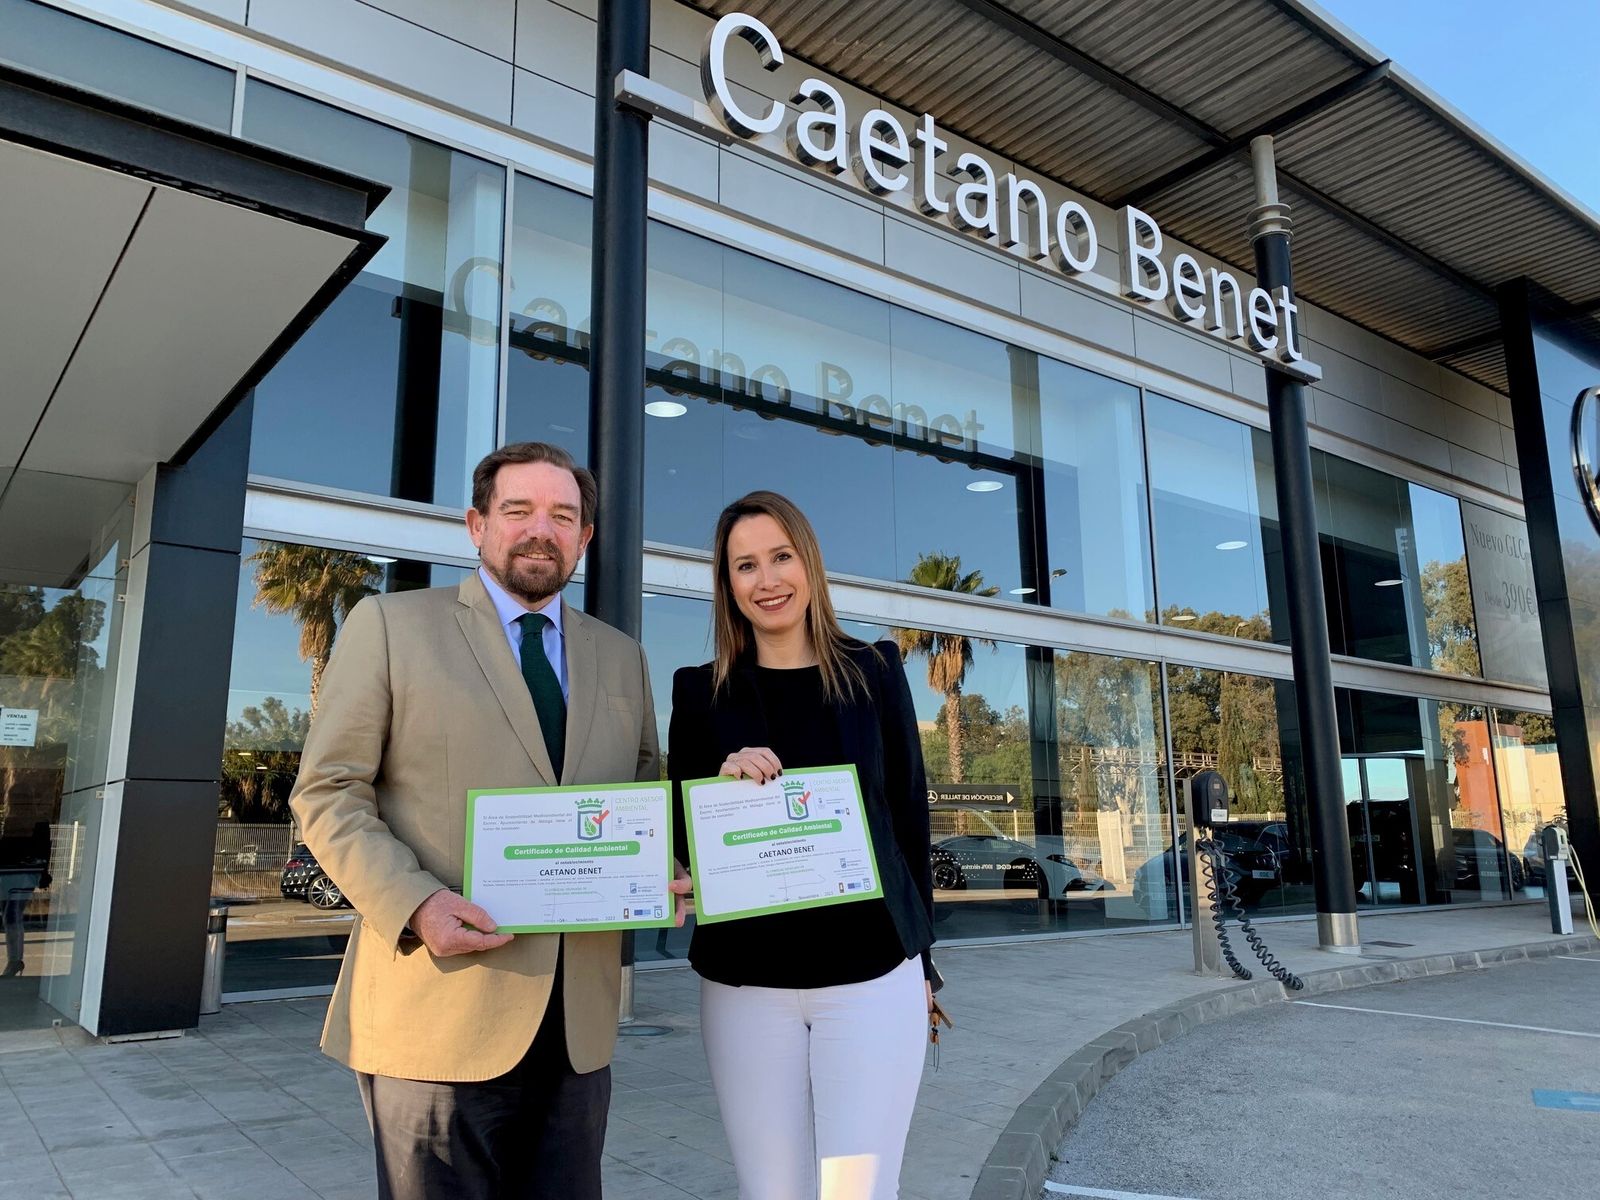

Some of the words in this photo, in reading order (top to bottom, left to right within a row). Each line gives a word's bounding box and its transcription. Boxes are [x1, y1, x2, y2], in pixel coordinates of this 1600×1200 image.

[702, 12, 1098, 275] Caetano
[1121, 205, 1304, 363] Benet
[448, 257, 792, 420] Caano
[815, 360, 985, 470] Benet
[1471, 523, 1503, 553] Nuevo
[1505, 534, 1527, 560] GLC
[1502, 581, 1536, 615] 390€
[732, 831, 768, 840] Certificado
[803, 822, 832, 831] Ambiental
[514, 847, 552, 856] Certificado
[565, 846, 591, 854] Calidad
[759, 848, 792, 859] CAETANO
[793, 845, 815, 854] BENET
[539, 868, 576, 876] CAETANO
[578, 867, 602, 875] BENET
